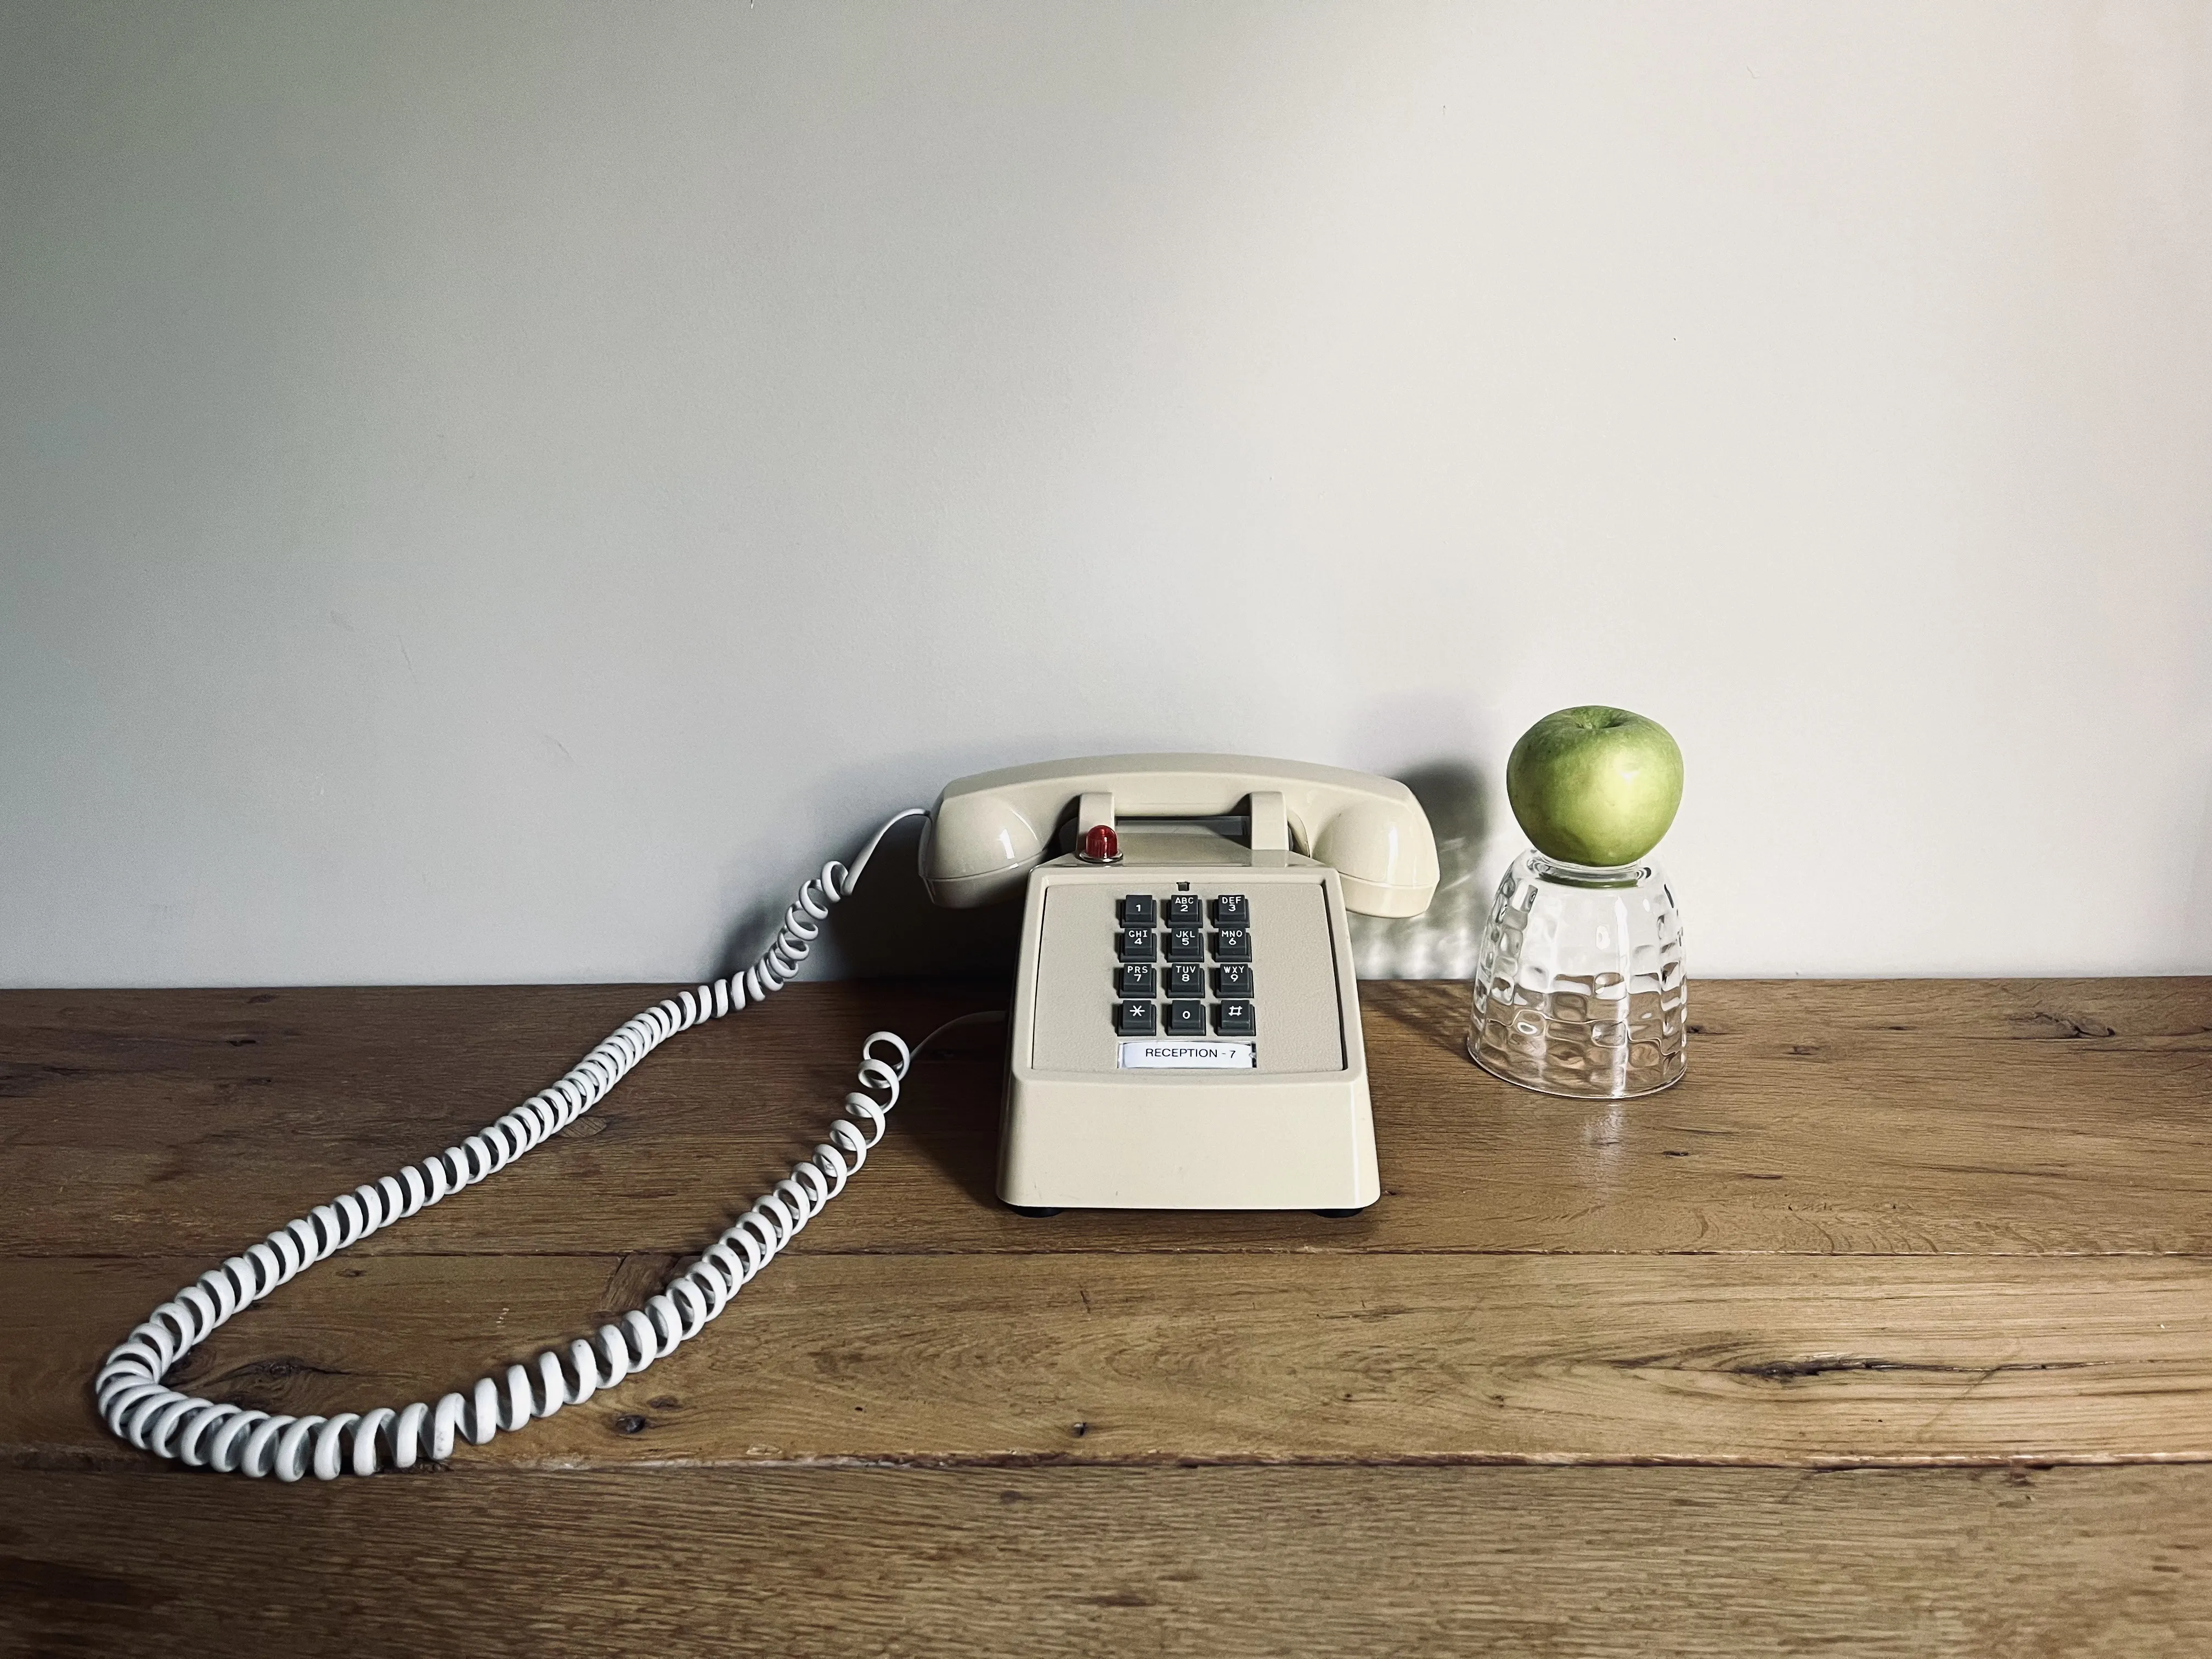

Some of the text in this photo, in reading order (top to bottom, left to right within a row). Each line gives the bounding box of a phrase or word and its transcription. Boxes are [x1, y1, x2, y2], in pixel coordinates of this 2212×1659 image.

[1182, 938, 1189, 946] 5
[1228, 937, 1237, 945] 6
[1176, 965, 1196, 973] TUV
[1133, 974, 1142, 982] 7
[1182, 973, 1190, 982] 8
[1230, 974, 1239, 982] 9
[1182, 1011, 1190, 1019] 0
[1228, 1006, 1243, 1016] #
[1146, 1048, 1217, 1058] RECEPTION
[1230, 1050, 1236, 1059] 7
